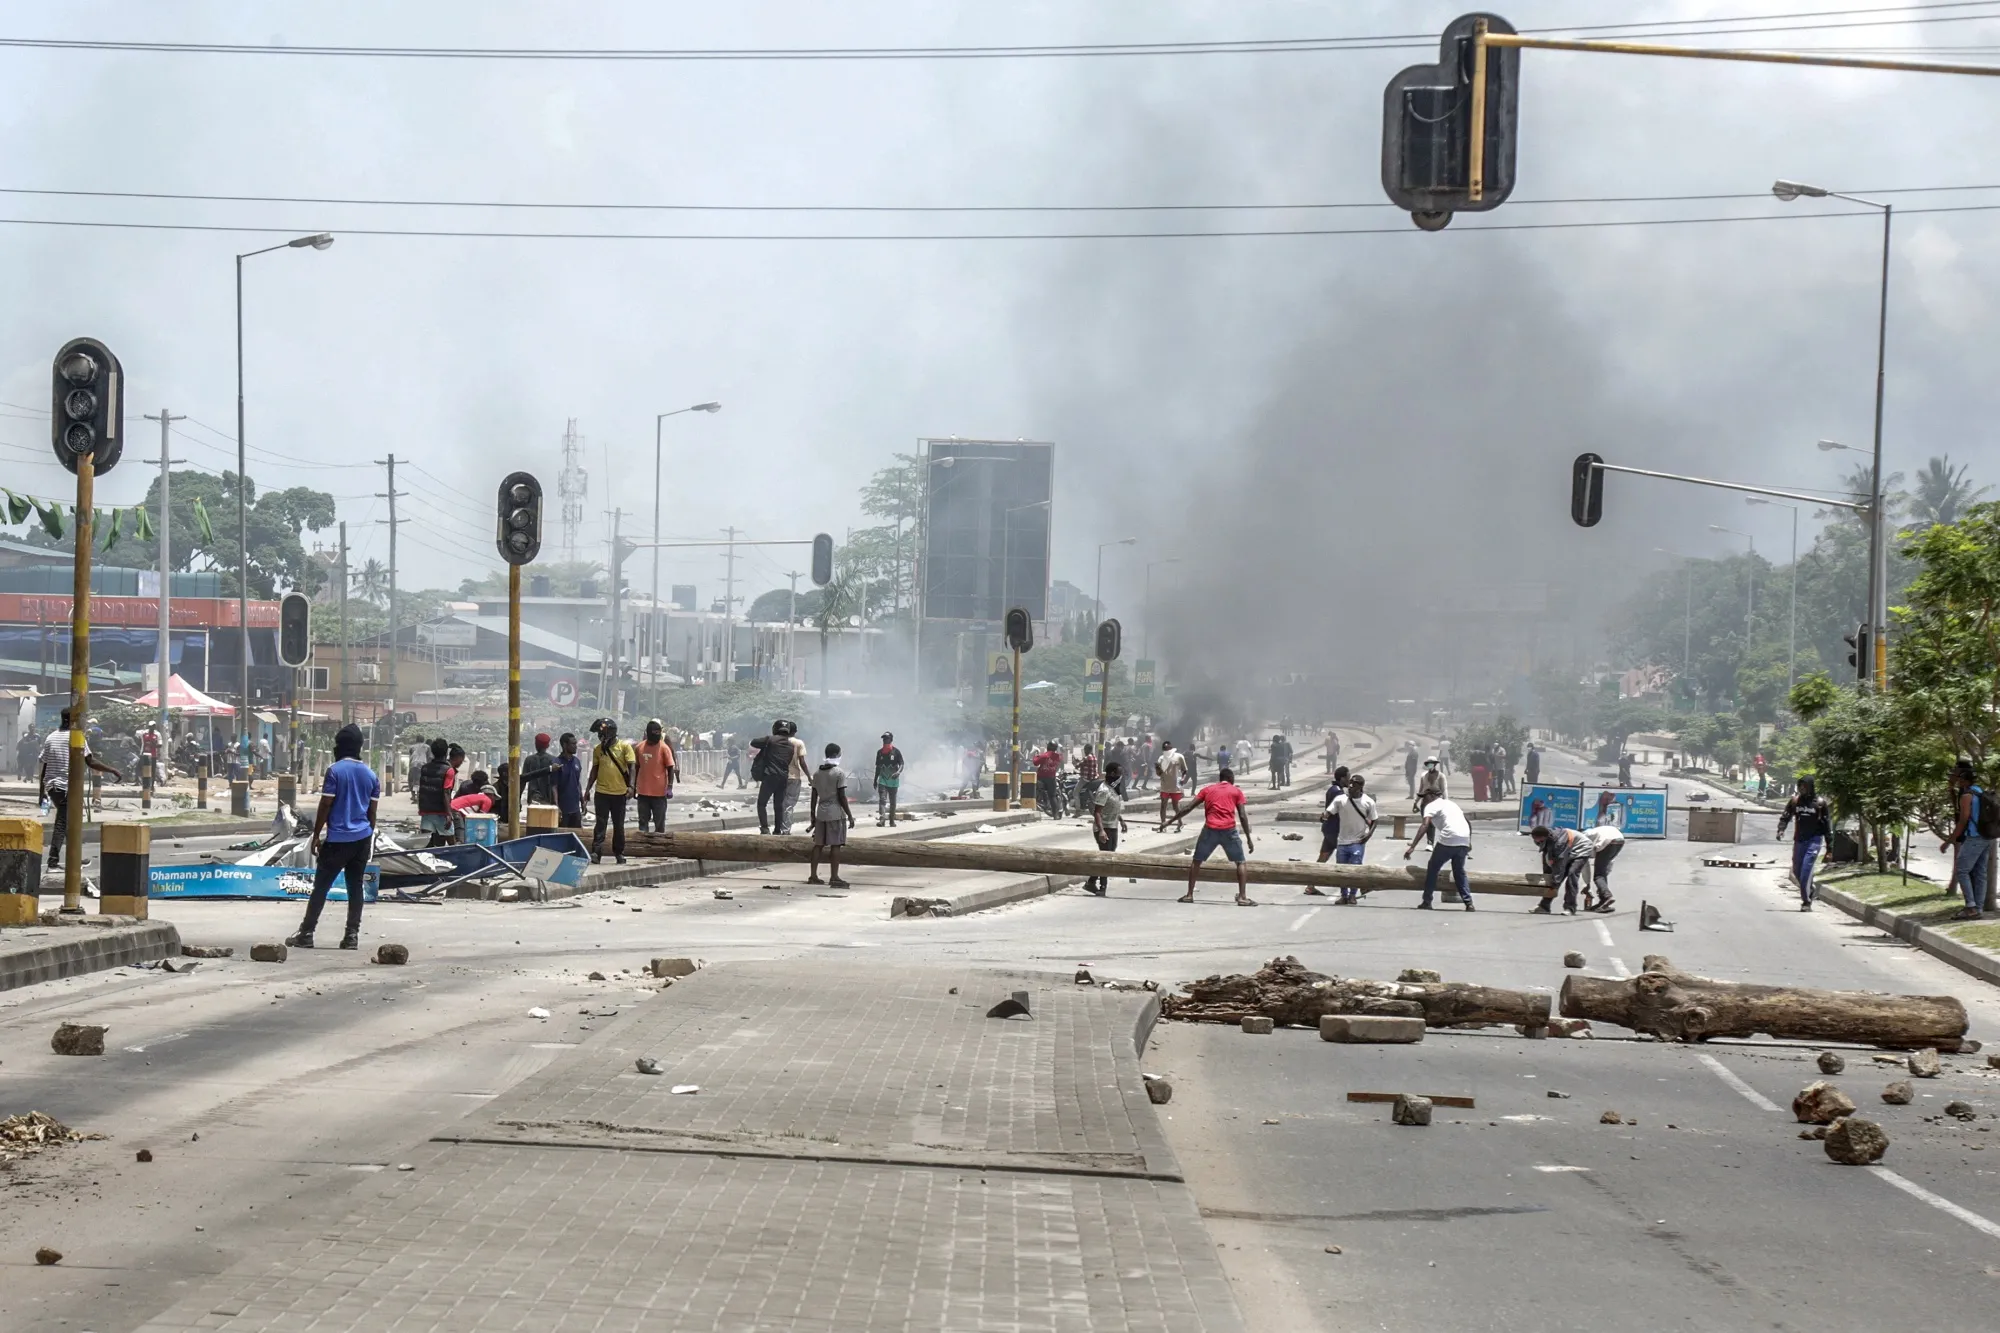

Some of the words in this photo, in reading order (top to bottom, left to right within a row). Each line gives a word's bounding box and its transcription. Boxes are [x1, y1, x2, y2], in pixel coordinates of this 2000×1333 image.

[557, 683, 572, 702] P
[151, 871, 198, 881] Dhamana
[200, 871, 212, 881] ya
[214, 869, 252, 880] Dereva
[152, 882, 185, 893] Makini
